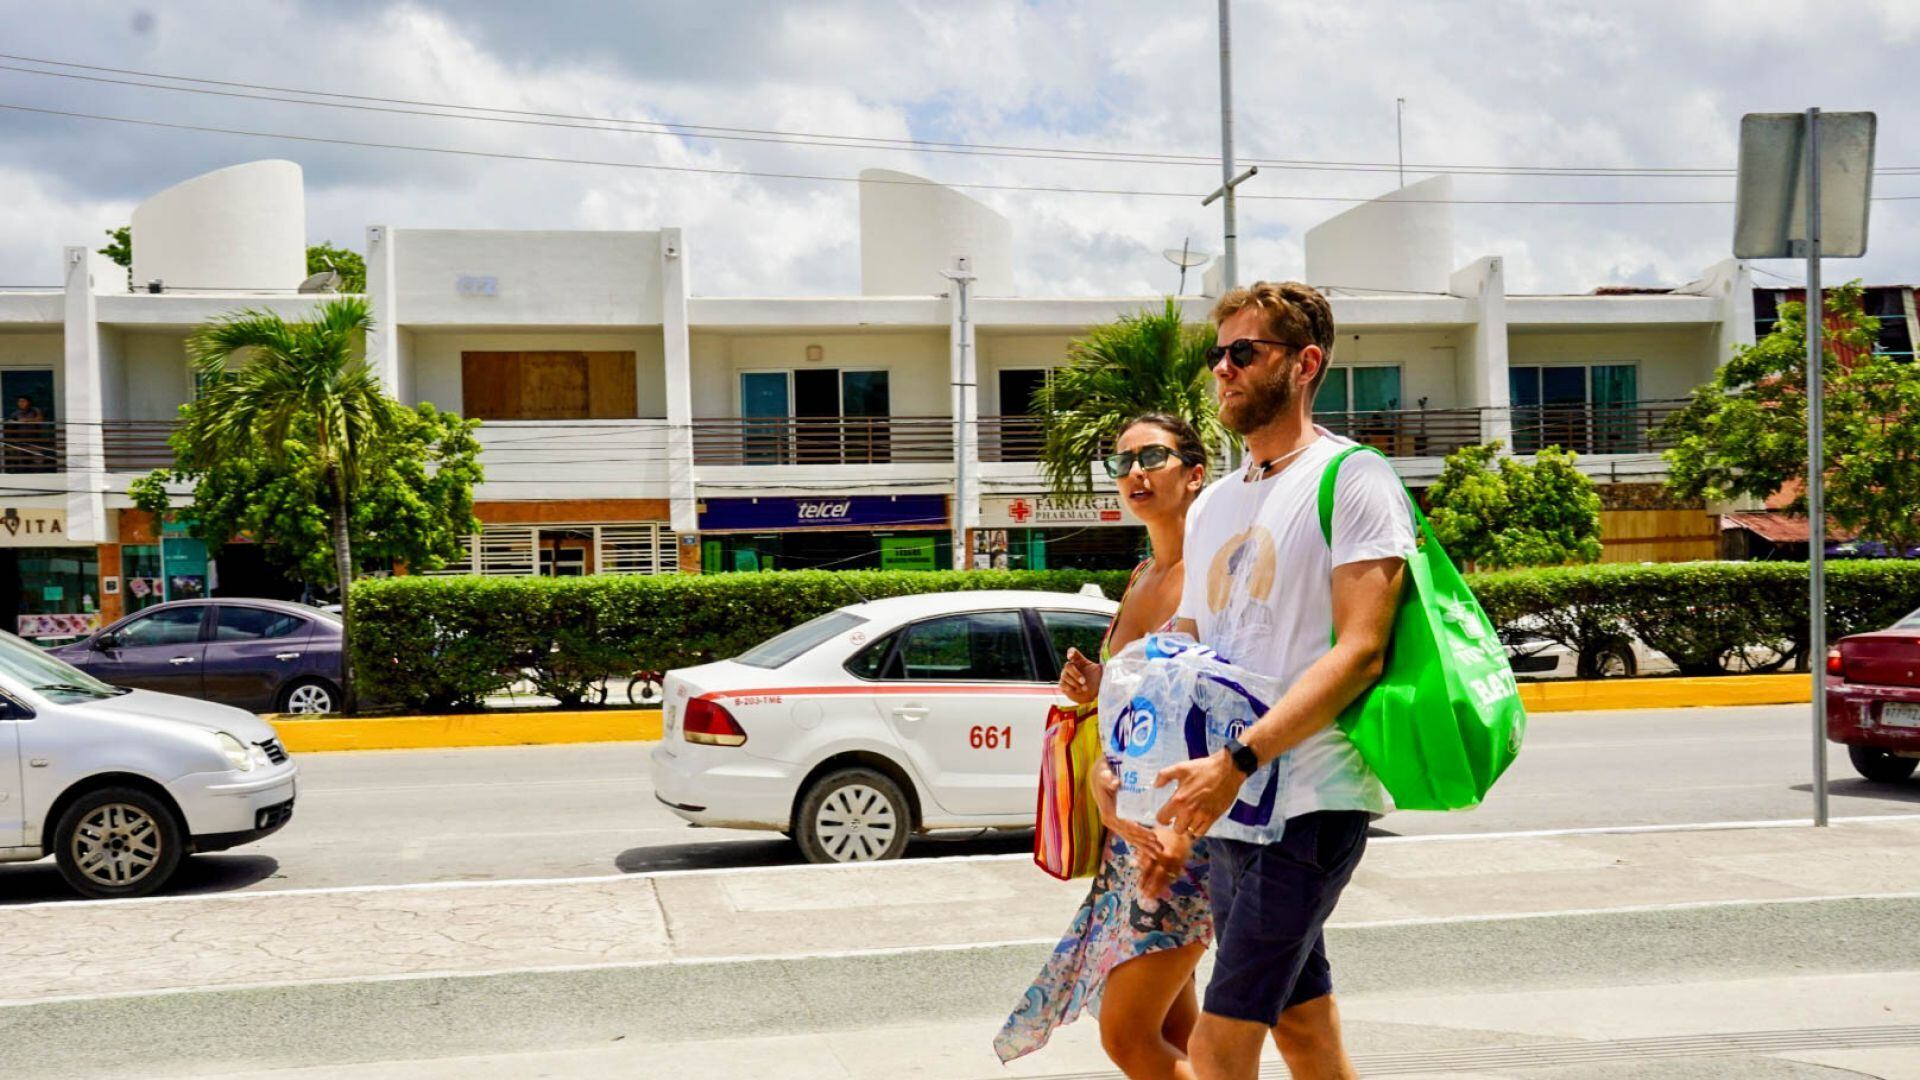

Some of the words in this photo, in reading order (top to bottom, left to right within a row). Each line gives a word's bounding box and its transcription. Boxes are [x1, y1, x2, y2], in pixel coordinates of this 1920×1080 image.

[797, 501, 852, 519] telcel
[1035, 497, 1121, 510] FARMACIA
[1035, 510, 1099, 520] PHARMACY
[969, 725, 1012, 750] 661
[1123, 770, 1138, 785] 15
